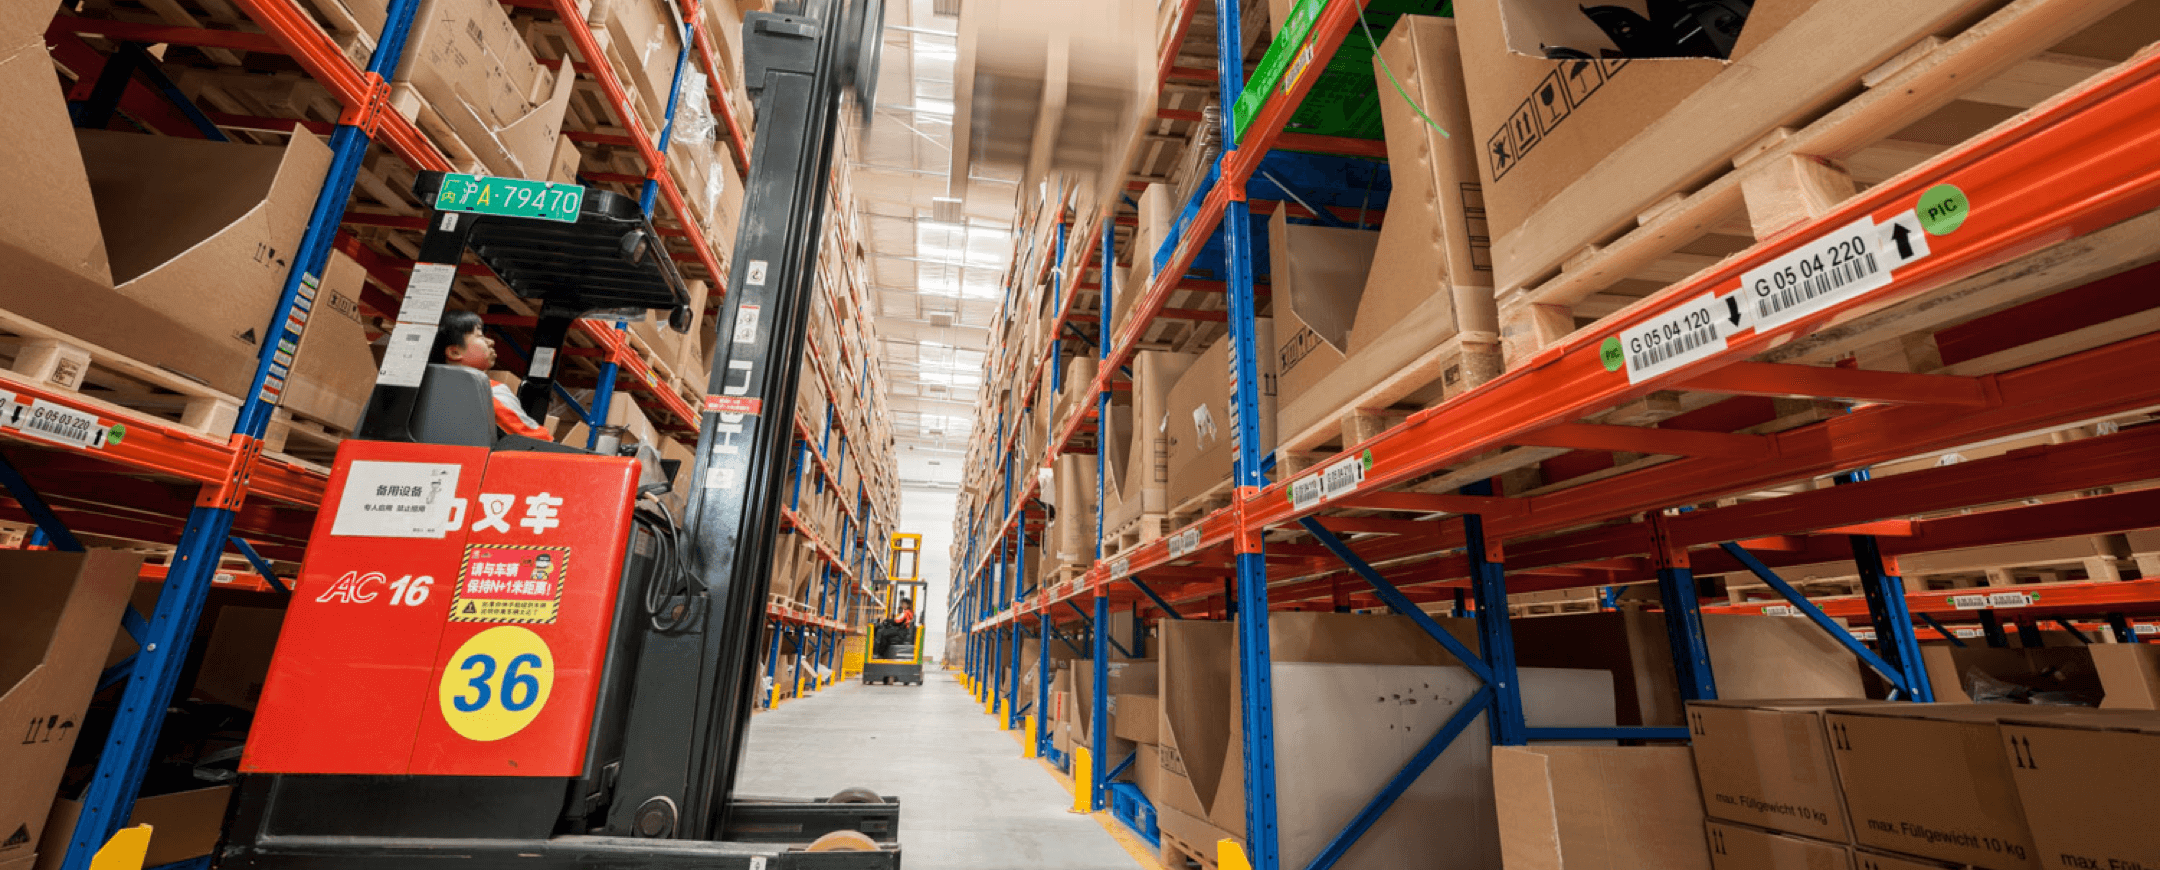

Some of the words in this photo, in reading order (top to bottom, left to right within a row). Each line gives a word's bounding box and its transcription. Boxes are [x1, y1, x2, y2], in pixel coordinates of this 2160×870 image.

[1928, 198, 1958, 222] PIC
[1755, 279, 1770, 297] G
[1774, 266, 1797, 290] 05
[1800, 253, 1824, 278] 04
[1828, 236, 1866, 267] 220
[1631, 337, 1642, 353] G
[1644, 329, 1661, 349] 05
[1663, 320, 1681, 340] 04
[1684, 308, 1710, 331] 120
[34, 407, 45, 418] G
[45, 410, 59, 422] 05
[59, 414, 72, 425] 03
[72, 417, 90, 430] 220
[376, 485, 423, 497] 备用设备
[471, 562, 520, 577] 请与车辆
[315, 571, 386, 603] AC
[389, 575, 434, 606] 16
[453, 653, 542, 712] 36
[1715, 793, 1738, 806] max.
[1739, 795, 1796, 816] Füllgewicht
[1797, 805, 1811, 819] 10
[1812, 808, 1828, 826] kg
[1867, 819, 1899, 835] max.
[1900, 821, 1980, 849] Füllgewicht
[1982, 837, 2001, 852] 10
[2004, 840, 2026, 860] kg
